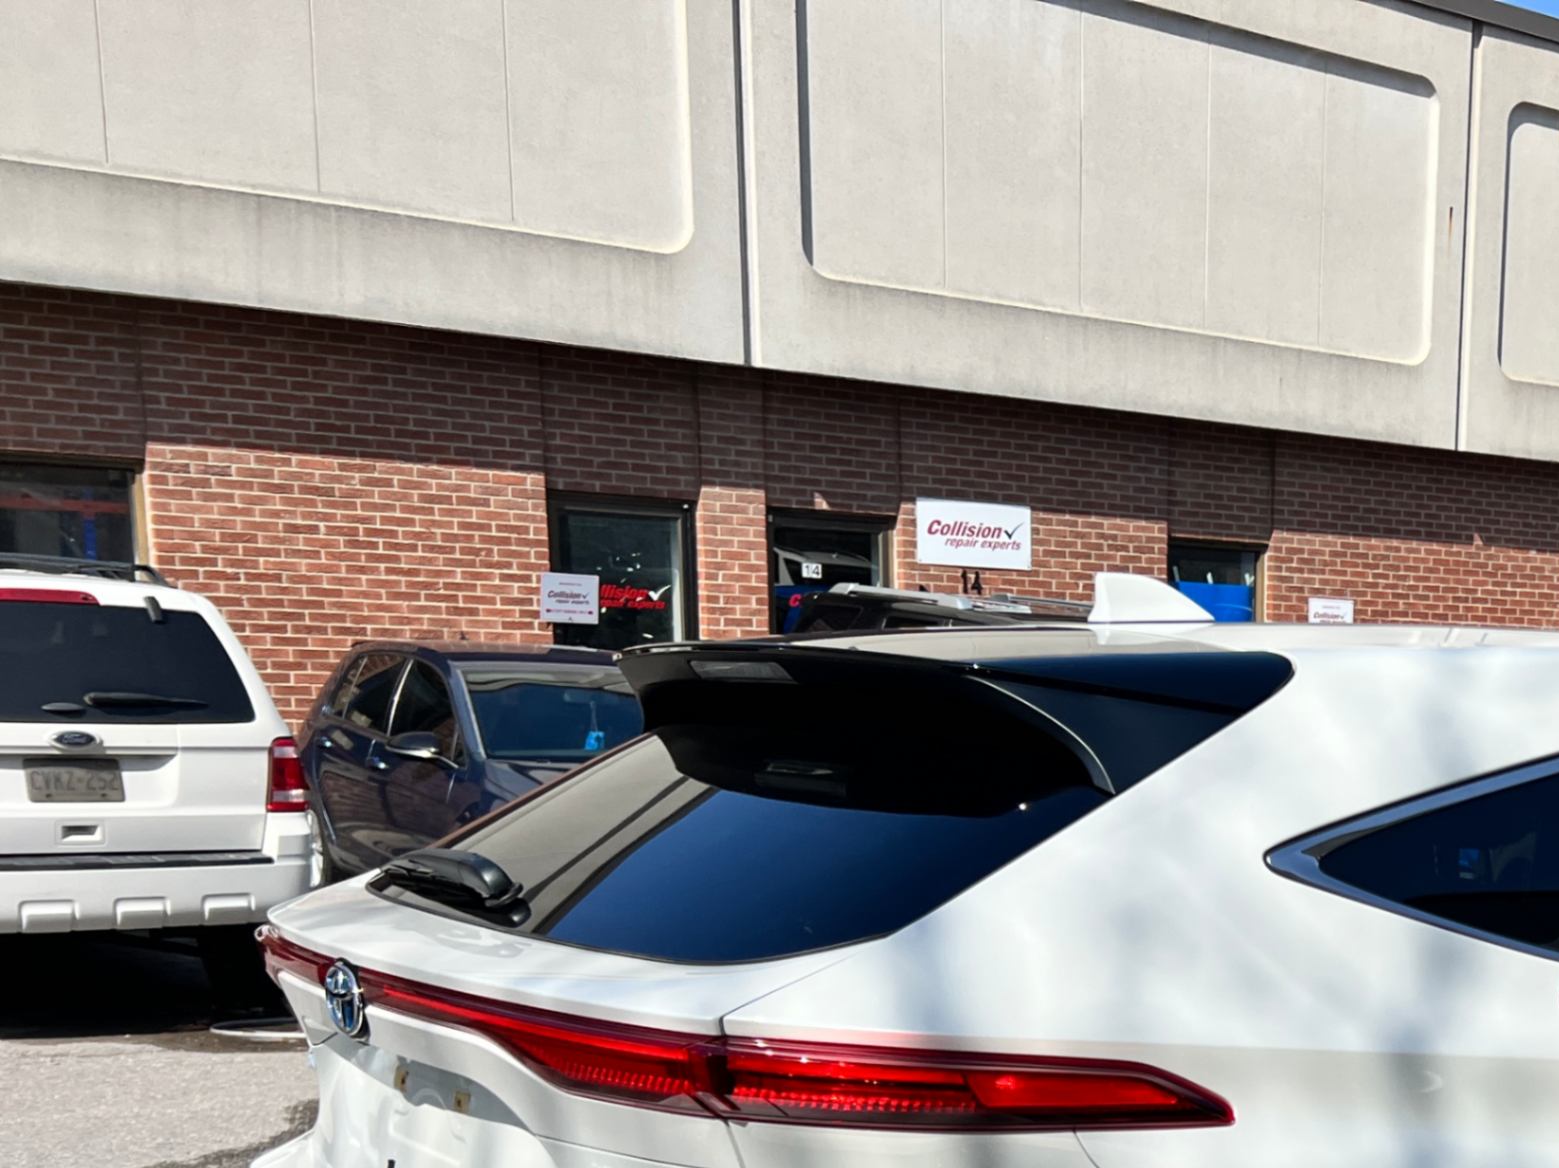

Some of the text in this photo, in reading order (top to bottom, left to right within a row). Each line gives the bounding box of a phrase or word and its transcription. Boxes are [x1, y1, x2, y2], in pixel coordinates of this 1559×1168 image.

[926, 519, 1002, 539] Collision
[944, 538, 1021, 552] repair experts
[804, 564, 821, 578] 14
[961, 570, 983, 595] 14
